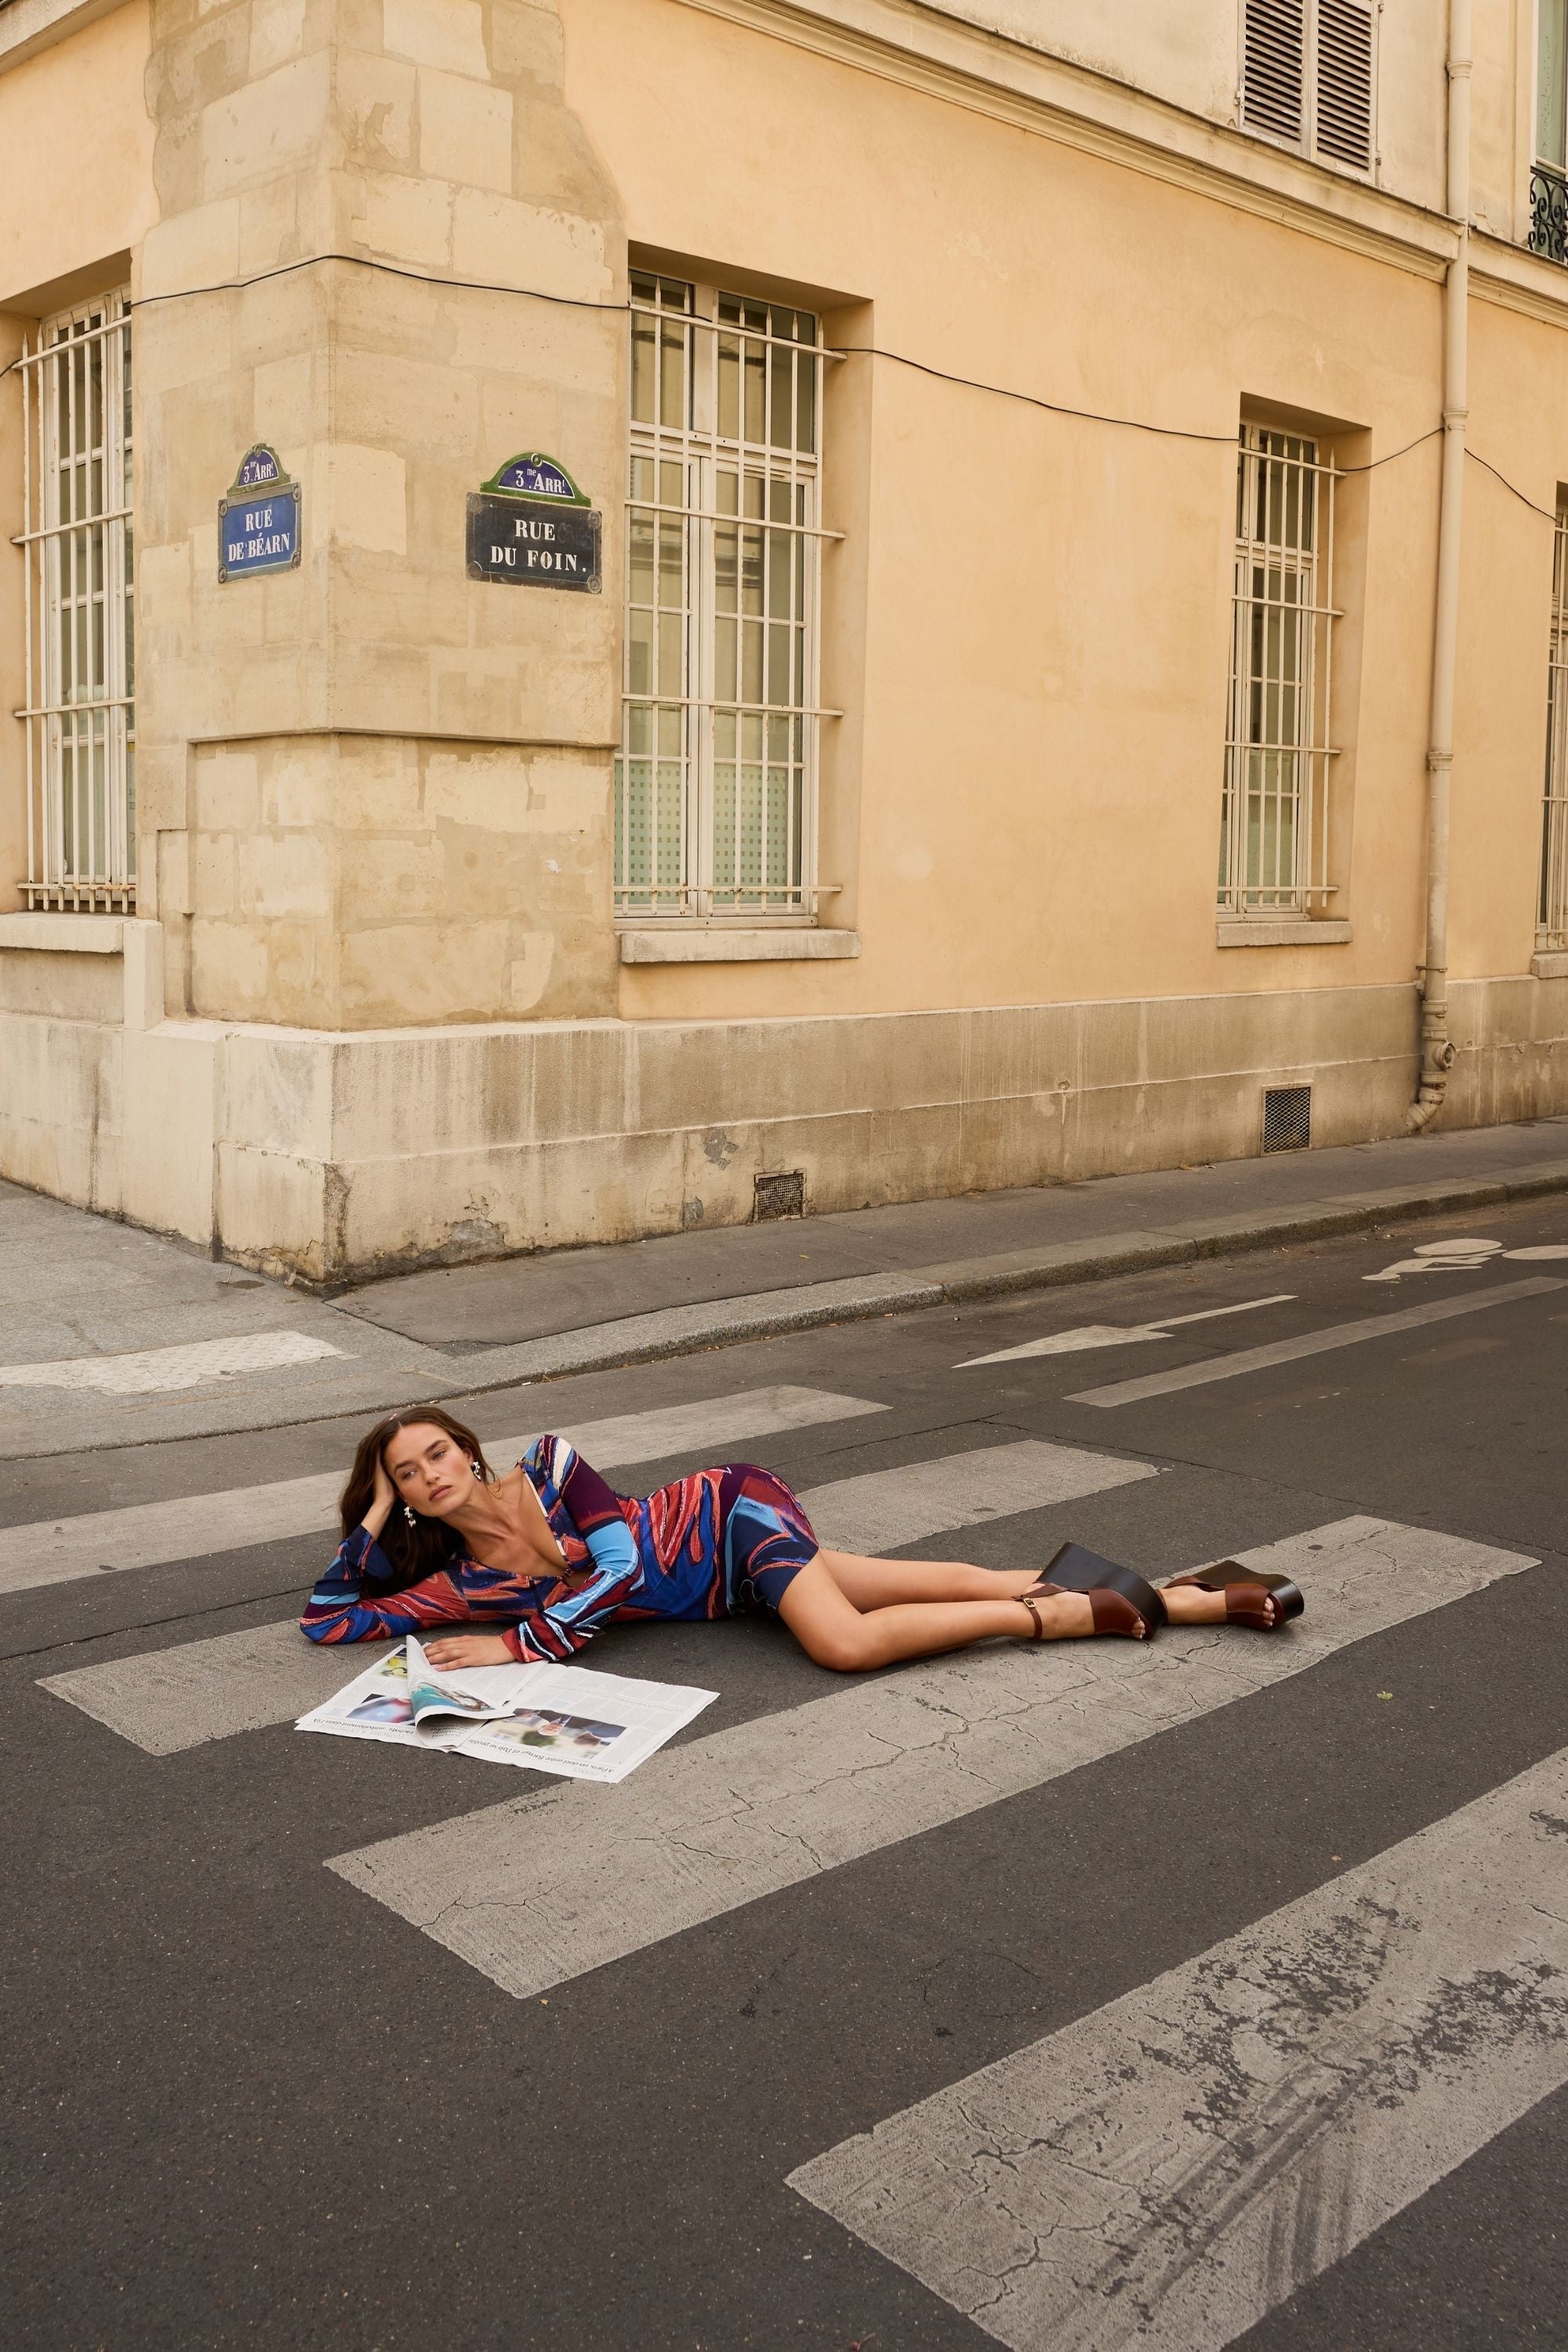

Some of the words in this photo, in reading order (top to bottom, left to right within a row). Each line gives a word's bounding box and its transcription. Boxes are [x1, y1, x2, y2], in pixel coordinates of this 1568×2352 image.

[245, 509, 272, 532] RUE
[515, 519, 555, 541] RUE
[229, 543, 244, 561] DE
[248, 532, 289, 558] BÉARN
[491, 546, 516, 566] DU
